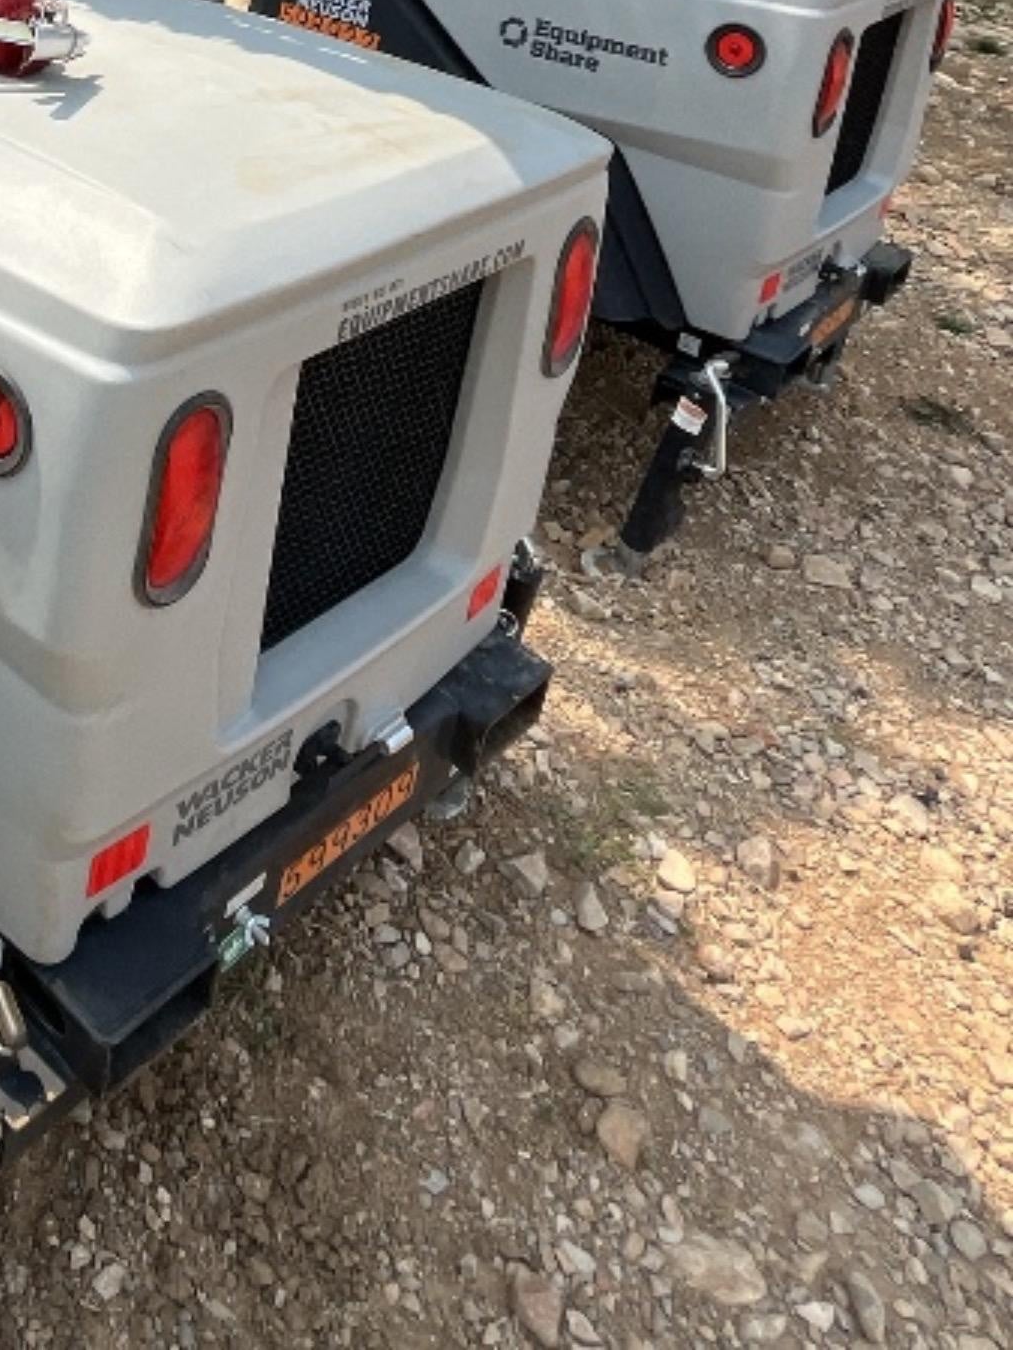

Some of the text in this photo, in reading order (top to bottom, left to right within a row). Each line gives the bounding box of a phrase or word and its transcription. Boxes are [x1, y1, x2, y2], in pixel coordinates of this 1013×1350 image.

[529, 39, 601, 73] Share
[534, 17, 669, 67] Equipment
[172, 750, 291, 847] NEUSON
[175, 729, 294, 820] WACKER
